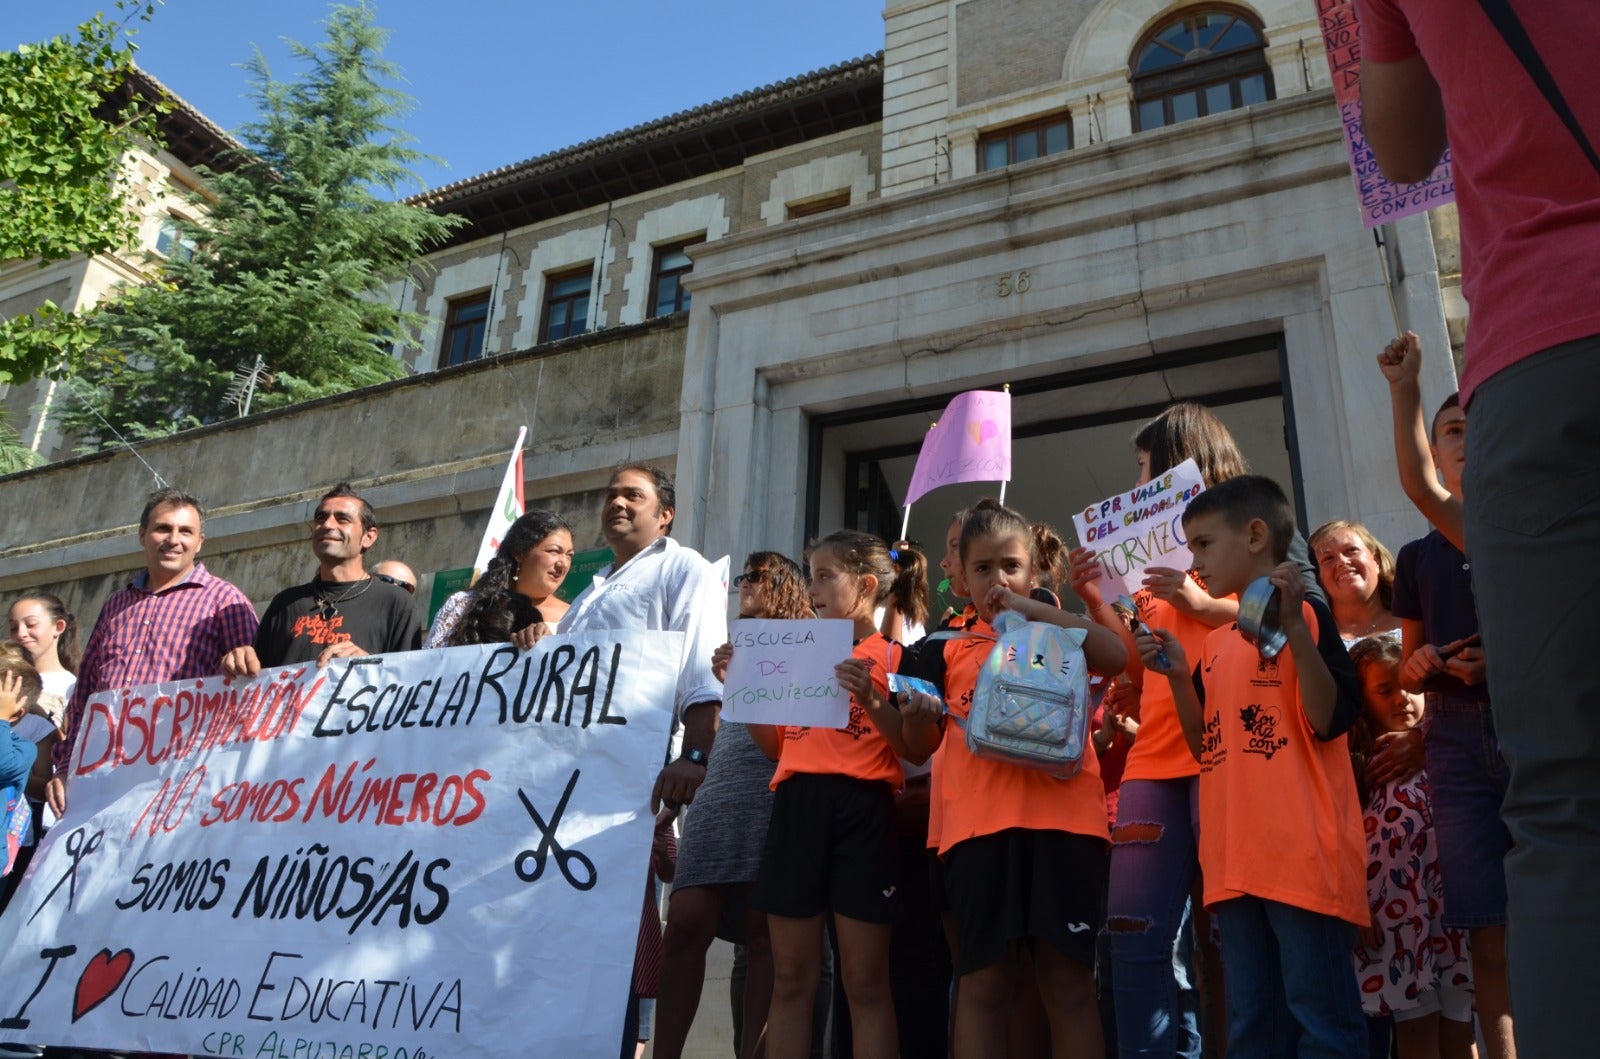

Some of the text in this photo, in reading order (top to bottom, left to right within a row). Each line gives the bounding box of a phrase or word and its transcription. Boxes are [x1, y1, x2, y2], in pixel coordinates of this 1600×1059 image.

[1371, 196, 1408, 219] CON
[997, 270, 1031, 298] 56
[1130, 473, 1173, 505] VALLE
[1086, 519, 1120, 543] DEL
[734, 630, 816, 648] ESCUELA
[756, 659, 789, 677] DE
[312, 658, 470, 738] ESCUELA
[466, 643, 628, 729] RURAL
[130, 757, 492, 840] NO SOMOS NÚMEROS
[115, 857, 231, 913] SOMOS
[120, 954, 242, 1021] CALIDAD
[246, 951, 462, 1034] EDUCATIVA
[202, 1031, 247, 1056] CPR
